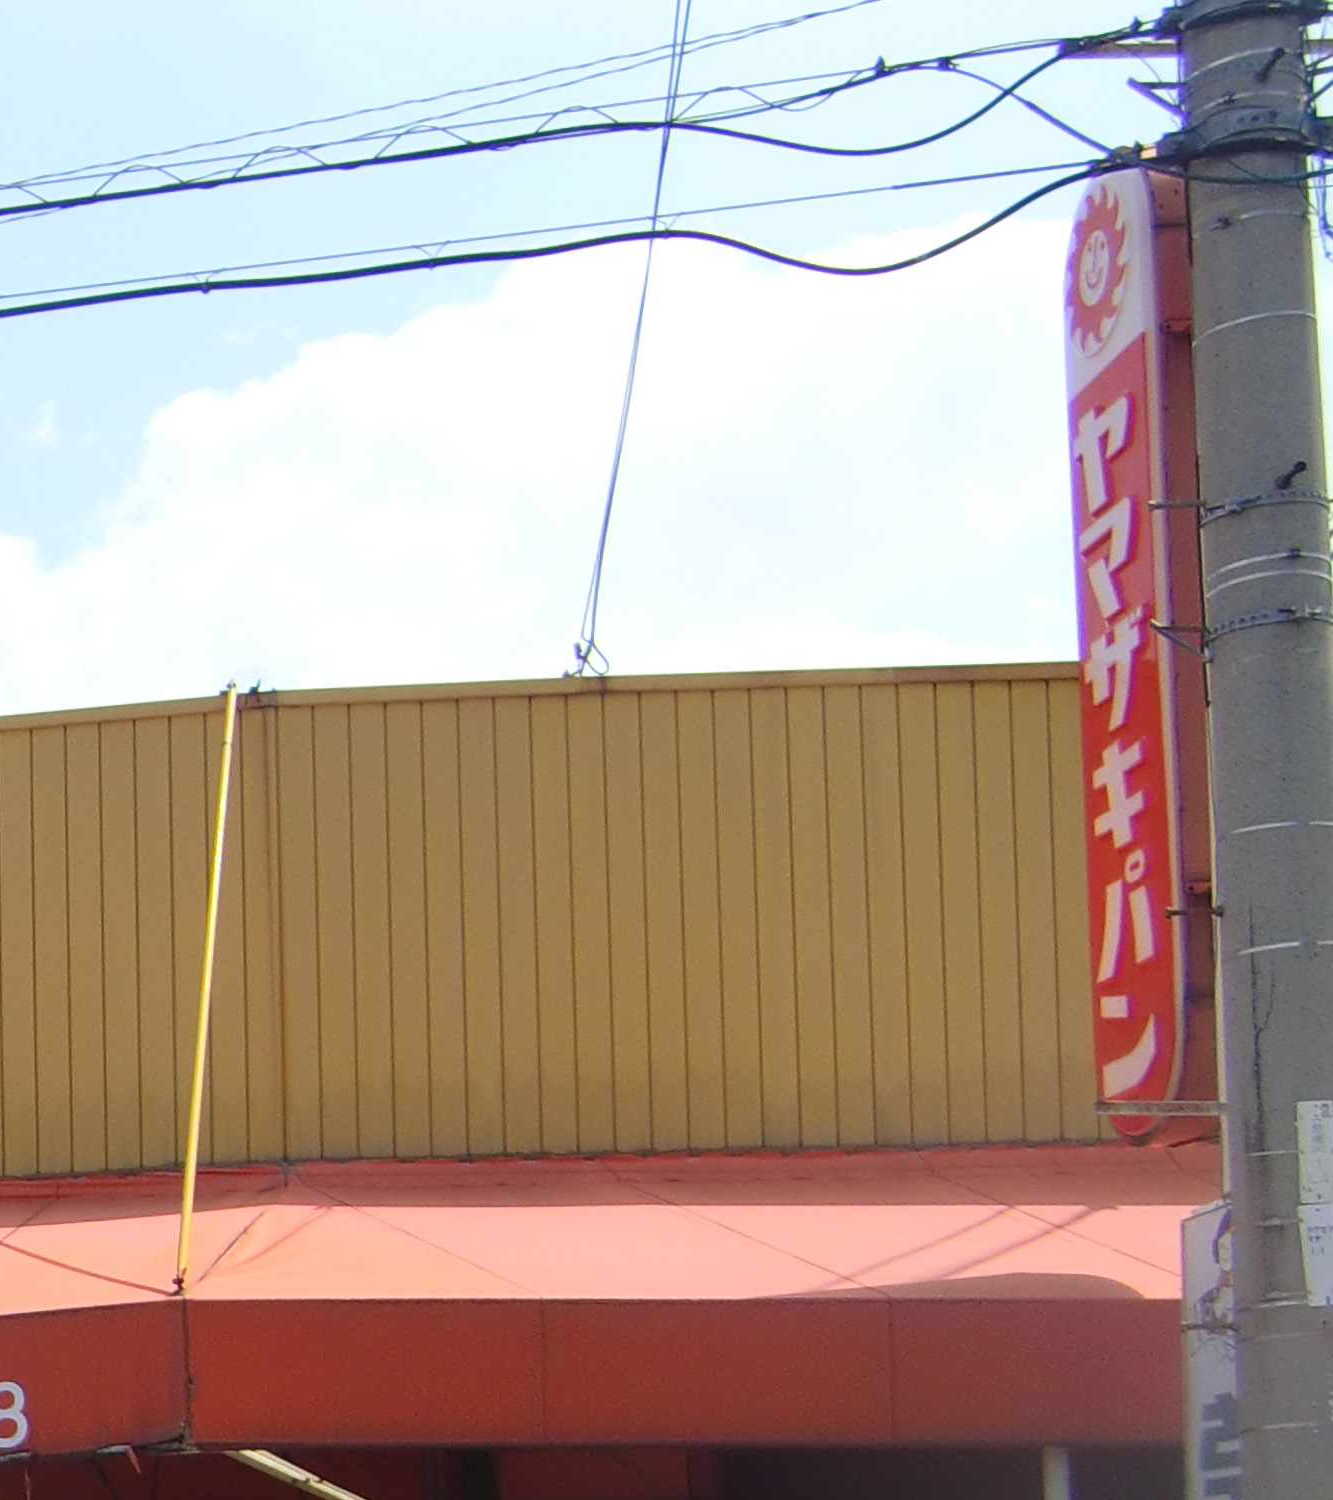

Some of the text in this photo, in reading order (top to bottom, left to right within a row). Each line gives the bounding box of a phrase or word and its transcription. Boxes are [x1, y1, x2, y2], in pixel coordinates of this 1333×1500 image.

[1073, 394, 1157, 1099] ヤマザキパン
